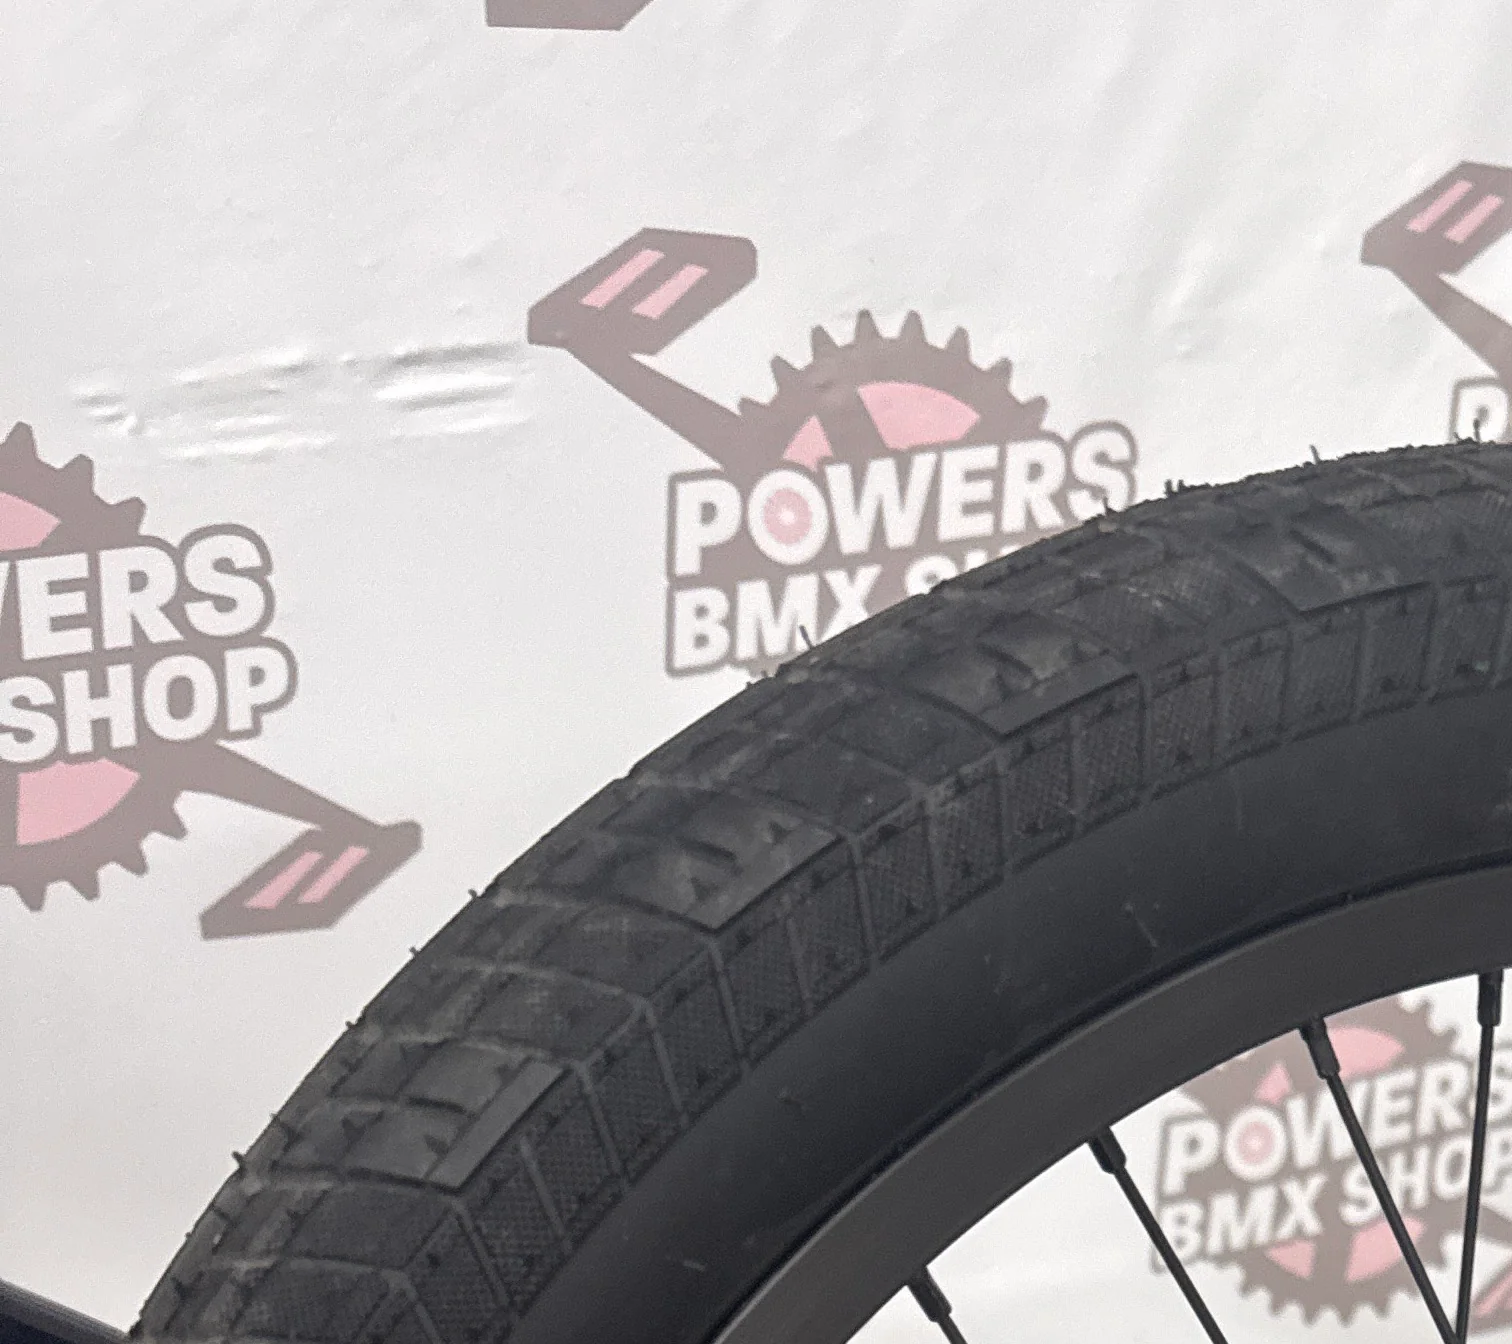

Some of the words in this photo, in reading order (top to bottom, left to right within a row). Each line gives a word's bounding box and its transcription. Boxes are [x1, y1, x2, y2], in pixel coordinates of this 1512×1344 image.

[673, 424, 1130, 577] POWERS
[0, 533, 266, 661] ERS
[670, 563, 883, 669] BMX
[0, 645, 290, 764] SHOP
[1156, 1174, 1330, 1267] BMX
